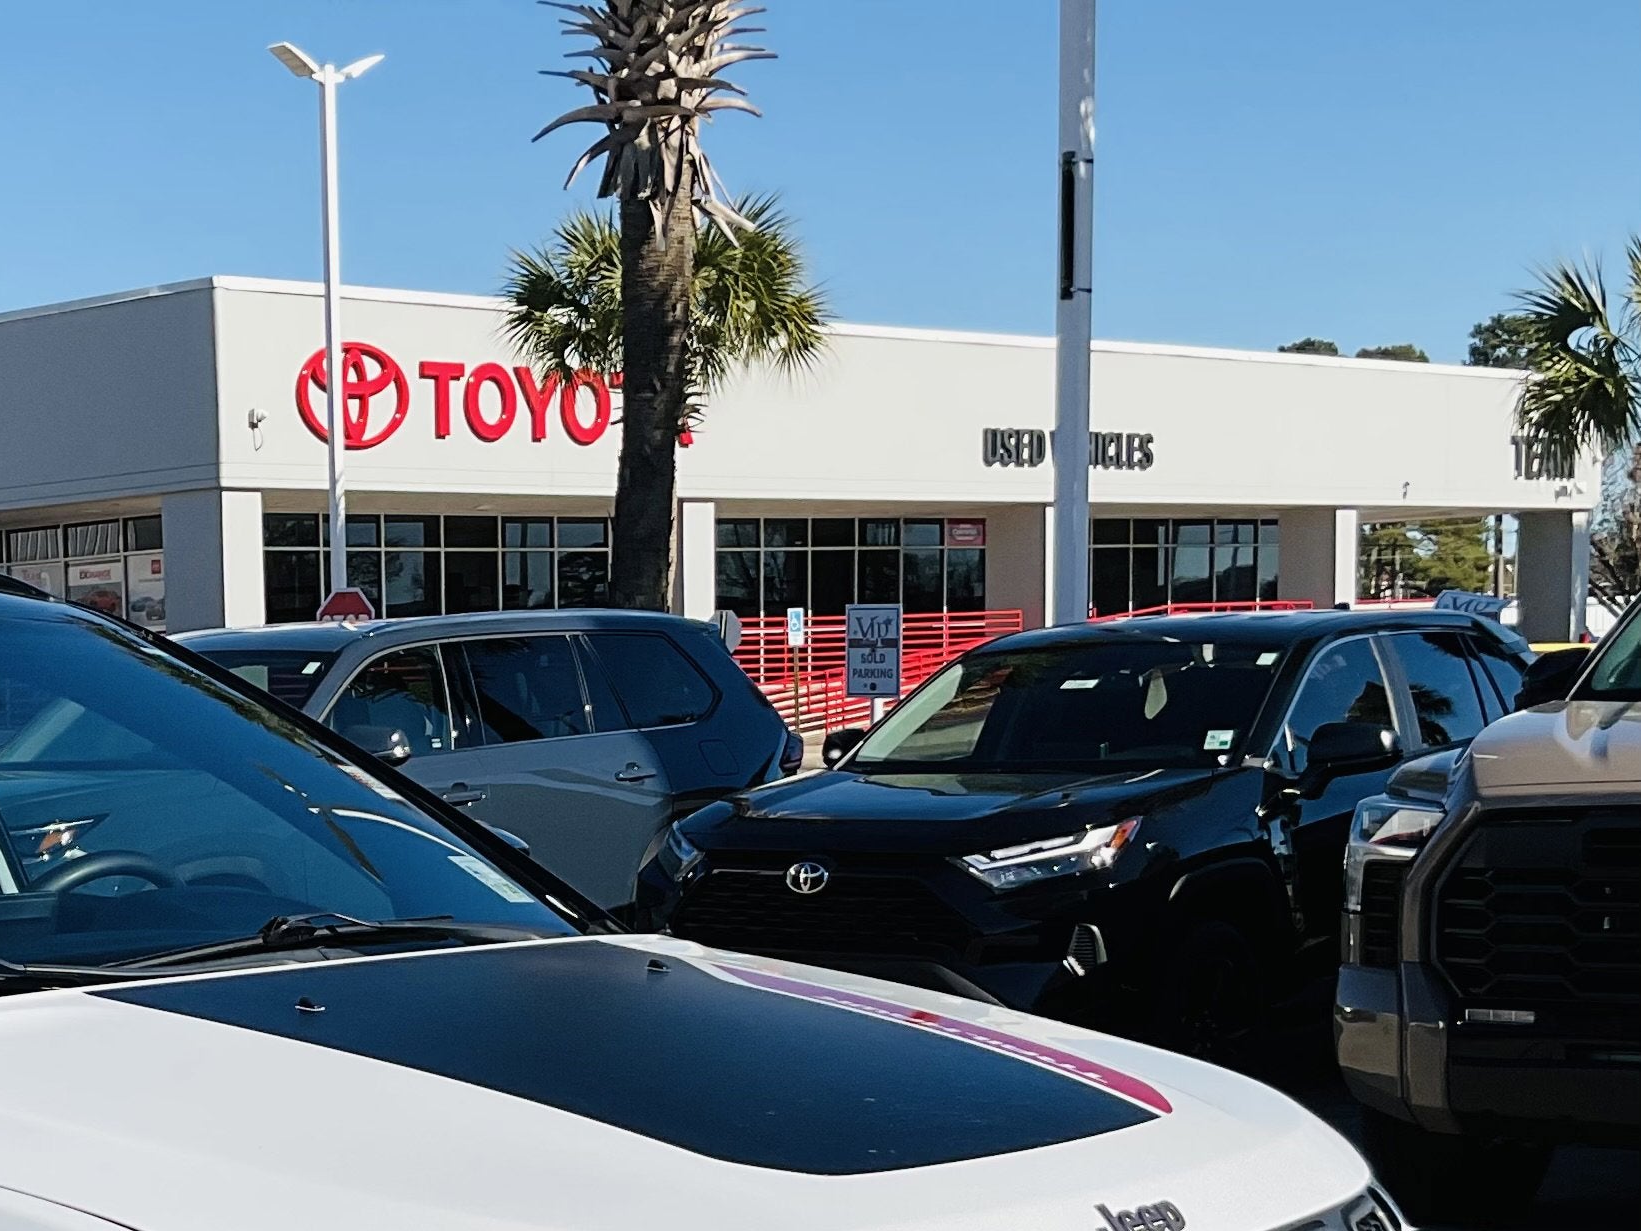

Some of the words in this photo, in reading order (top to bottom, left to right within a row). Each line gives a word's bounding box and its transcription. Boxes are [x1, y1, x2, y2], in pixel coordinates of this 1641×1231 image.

[419, 360, 694, 448] TOYO
[982, 428, 1046, 468] USED
[860, 652, 886, 664] SOLD
[852, 668, 894, 679] PARKING
